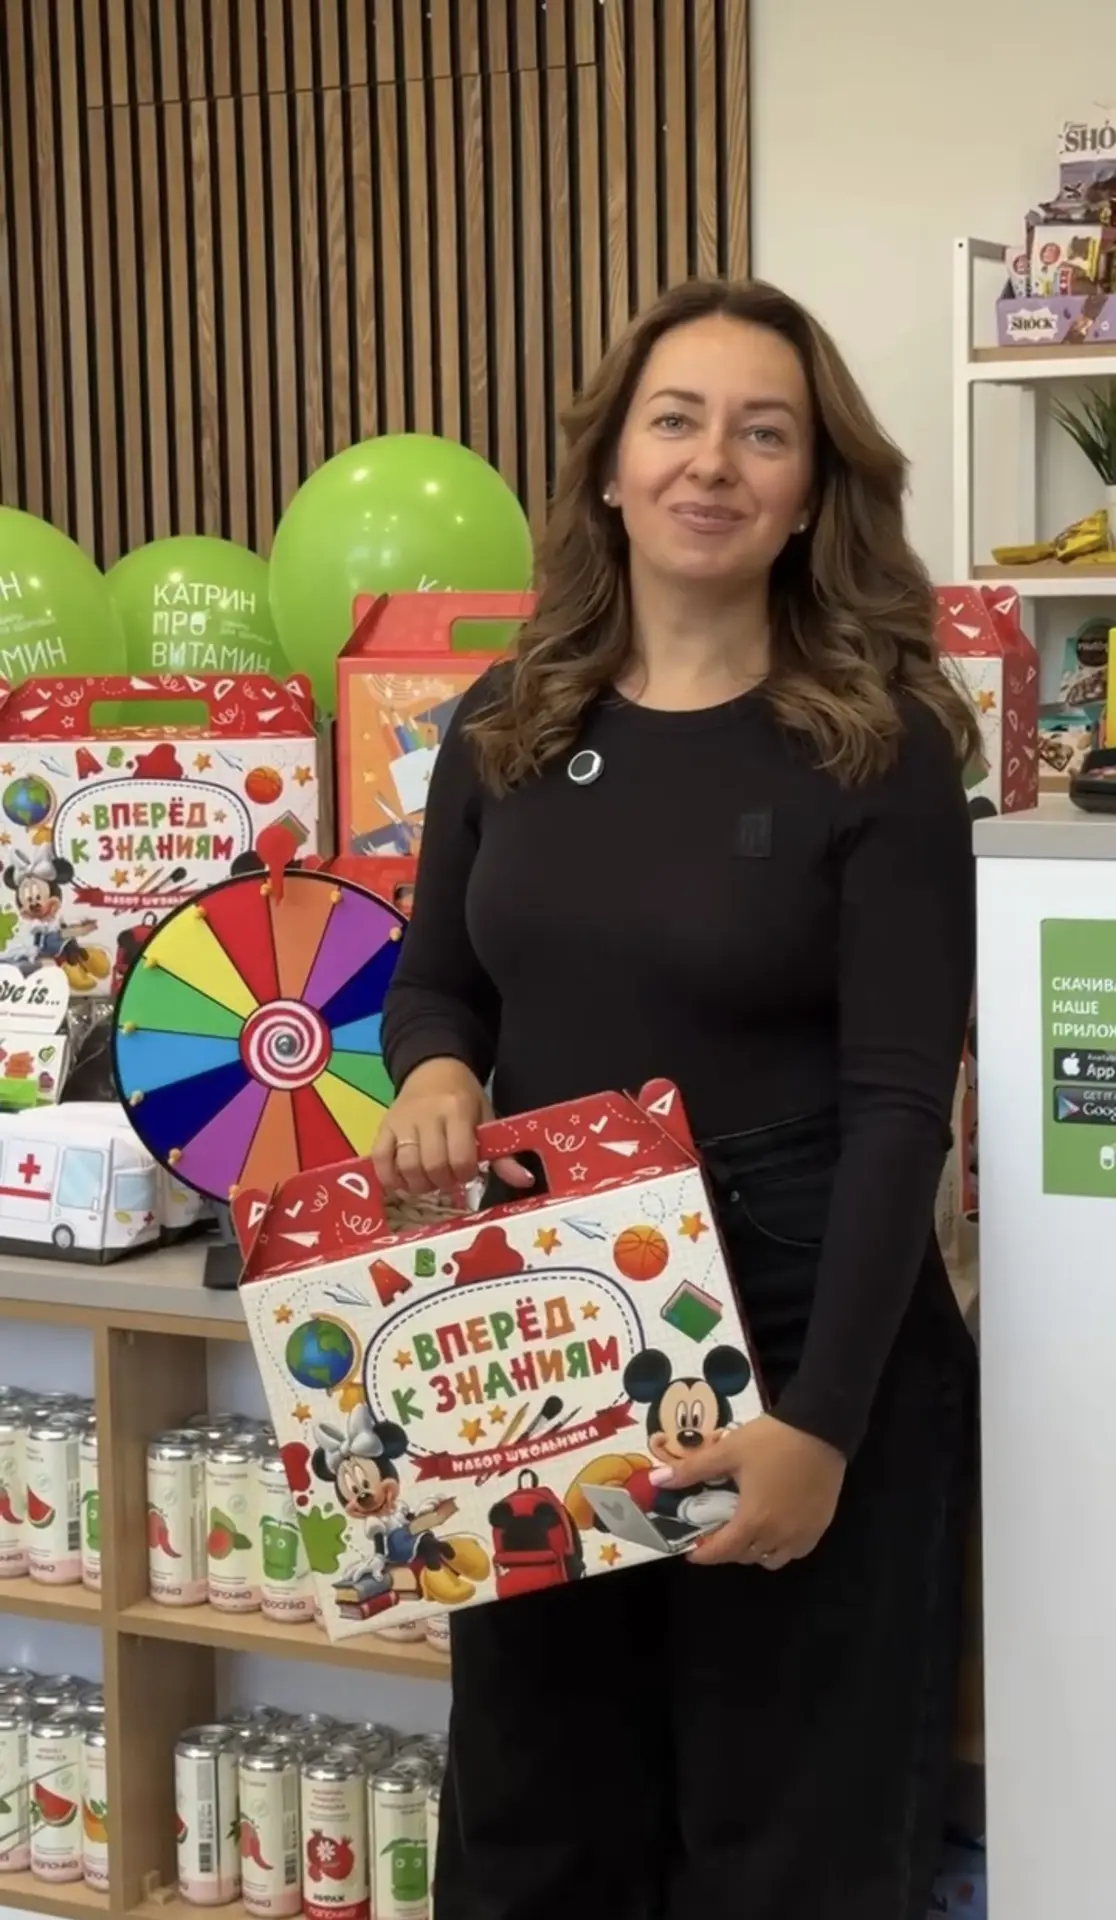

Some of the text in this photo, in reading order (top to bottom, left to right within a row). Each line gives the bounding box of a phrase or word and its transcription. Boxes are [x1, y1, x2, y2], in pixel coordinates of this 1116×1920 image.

[153, 582, 256, 614] КАТРИН
[153, 608, 208, 636] ПРО
[152, 641, 271, 674] ВИТАМИН
[93, 797, 208, 831] ВПЕРЁД
[99, 834, 234, 861] ЗНАНИЯМ
[1052, 1000, 1099, 1015] НАШЕ
[1086, 1063, 1115, 1080] App
[1083, 1090, 1101, 1100] GET
[412, 1296, 576, 1371] ВПЕРЁД
[429, 1336, 620, 1414] ЗНАНИЯМ
[452, 1425, 600, 1473] НАБОР ШКОЛЬНИКА
